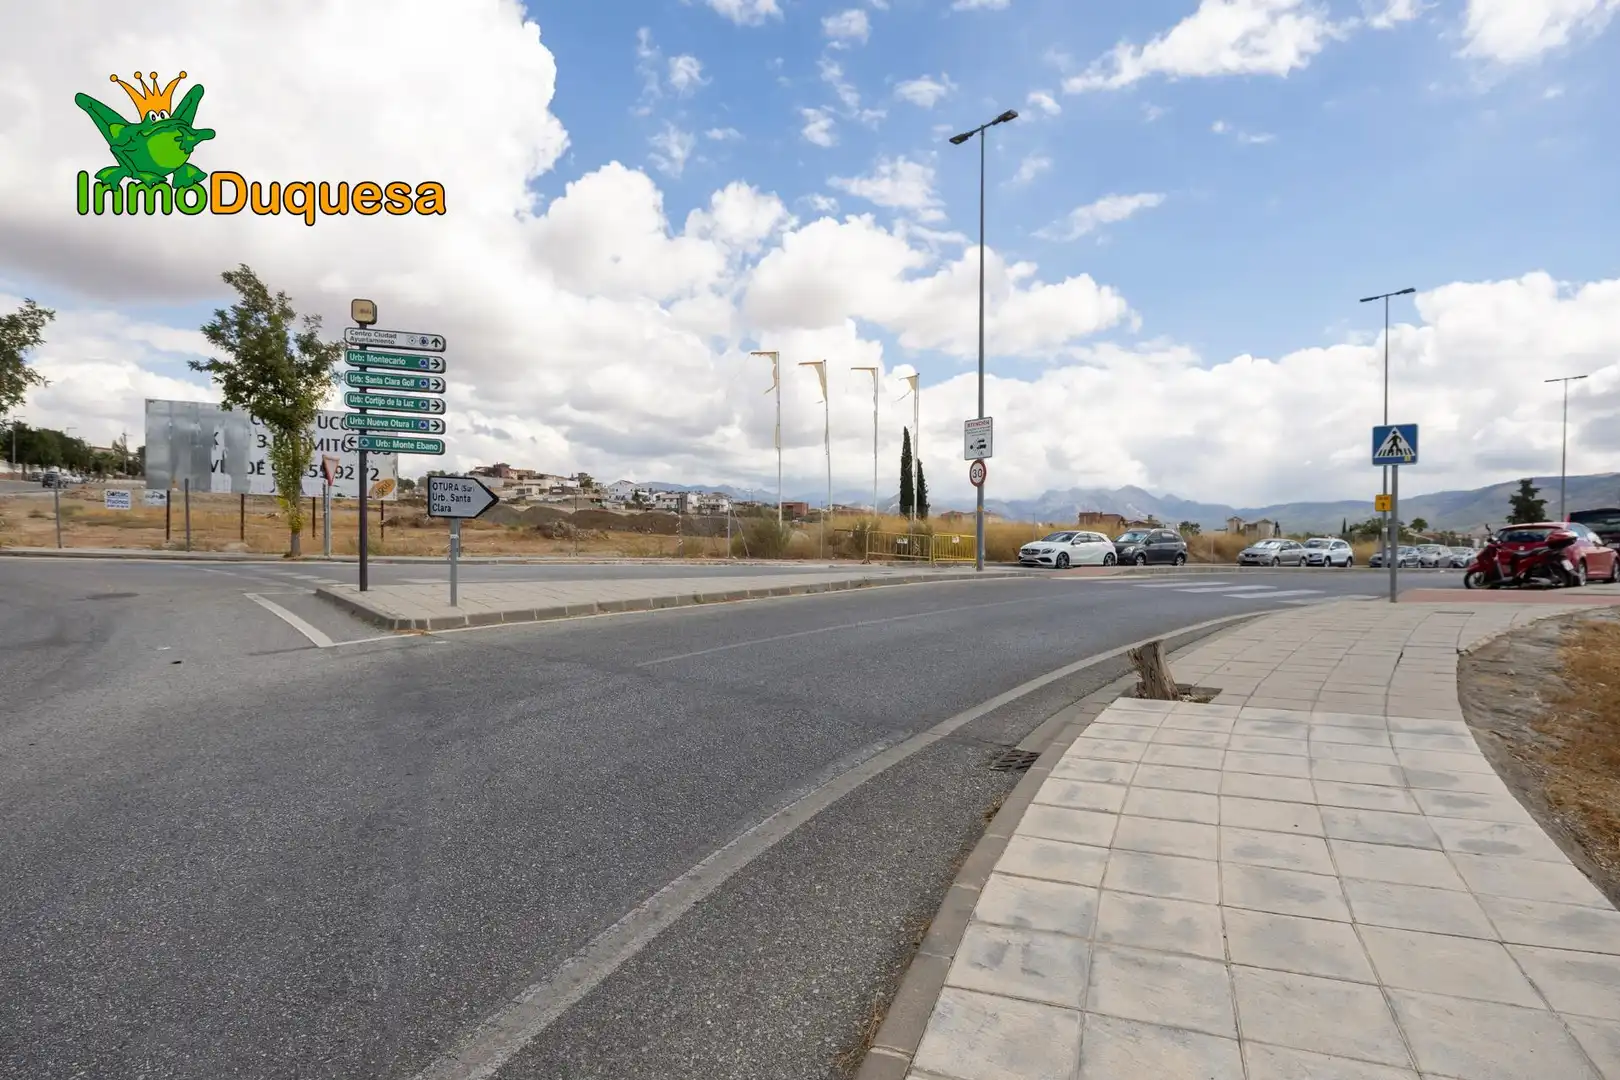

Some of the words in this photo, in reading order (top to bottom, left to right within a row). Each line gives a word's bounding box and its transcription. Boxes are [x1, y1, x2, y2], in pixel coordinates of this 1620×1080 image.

[349, 329, 372, 337] Centro
[373, 331, 397, 339] Ciudad
[349, 336, 395, 345] Ayuntamiento
[366, 354, 406, 365] Montecarlo
[365, 375, 383, 384] Santa
[384, 377, 400, 386] Clara
[401, 378, 415, 386] Golf
[364, 396, 386, 406] Cortijo
[386, 398, 395, 406] de
[395, 398, 402, 406] la
[403, 399, 414, 407] Luz
[366, 418, 389, 426] Nueva
[390, 419, 410, 428] Otura
[392, 440, 415, 449] Monte
[416, 441, 438, 451] Ebano
[972, 468, 983, 478] 30
[432, 482, 459, 491] OTURA
[432, 493, 448, 502] Urb.
[450, 493, 471, 503] Santa
[432, 503, 452, 512] Clara
